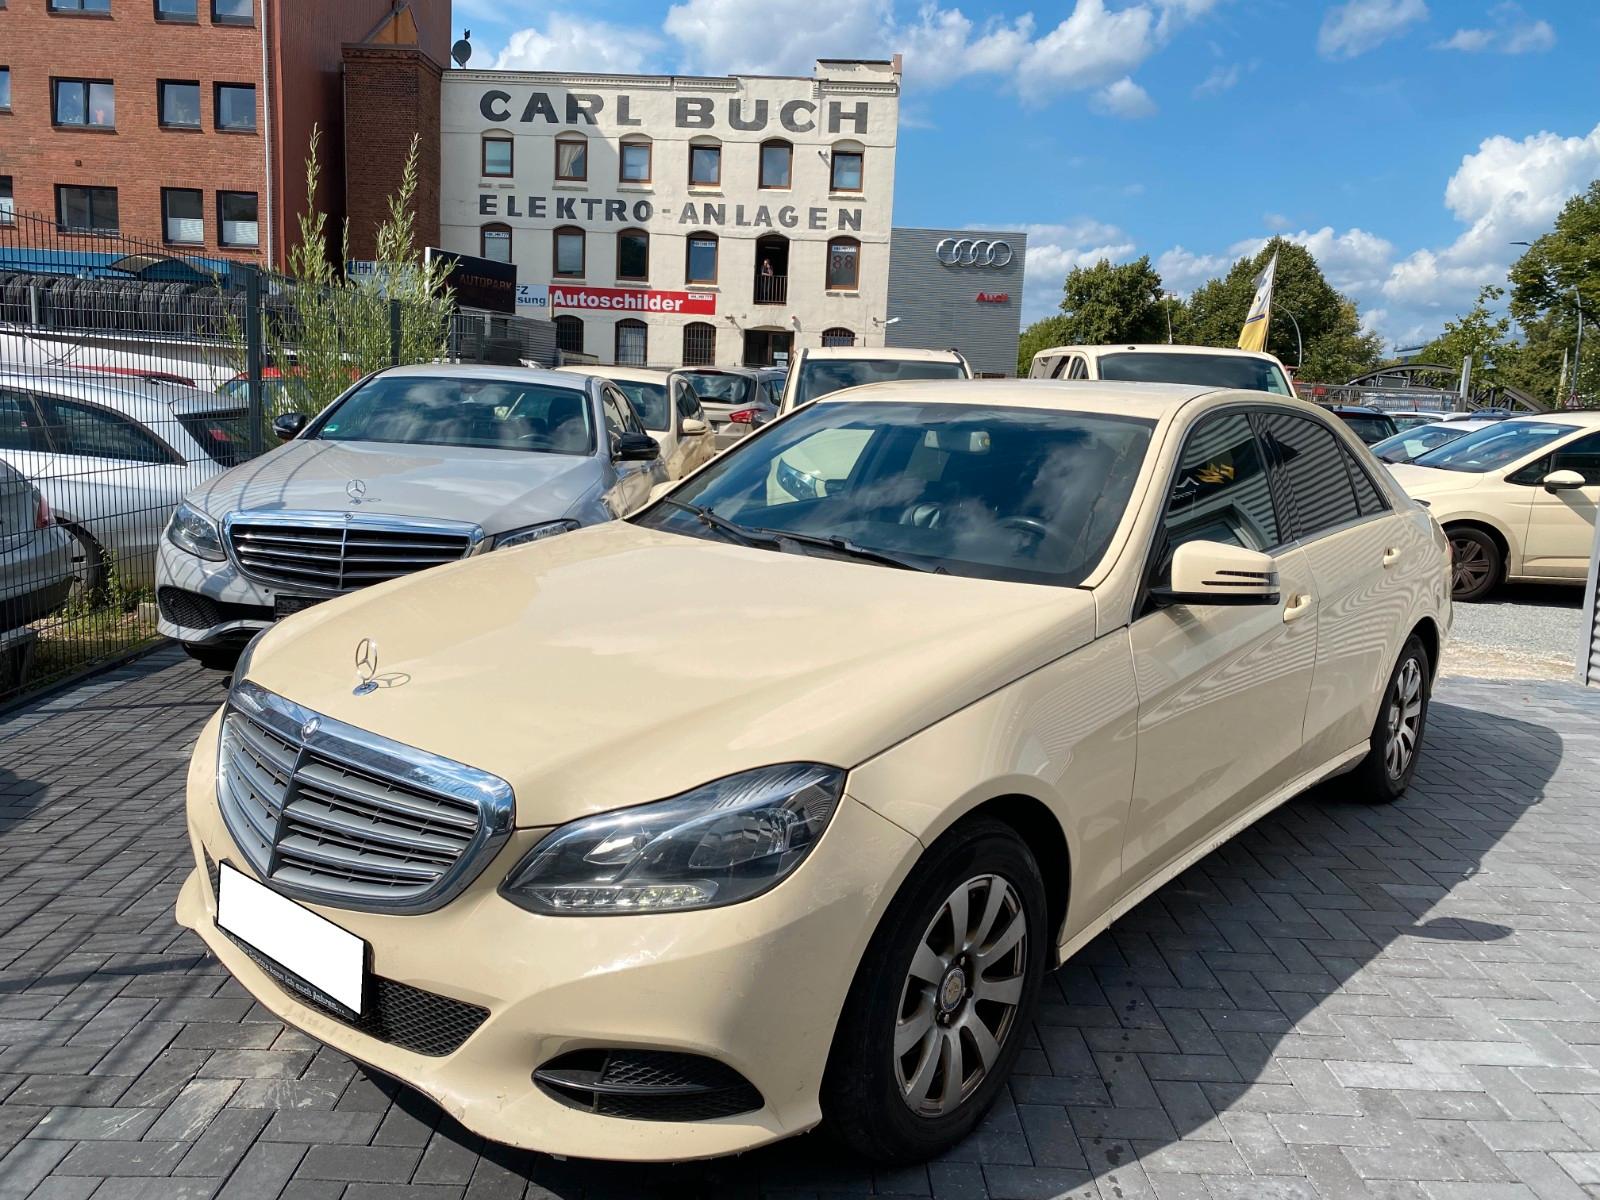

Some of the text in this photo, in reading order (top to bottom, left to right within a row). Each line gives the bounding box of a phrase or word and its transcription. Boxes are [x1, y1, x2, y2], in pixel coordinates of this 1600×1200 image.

[479, 90, 869, 134] CARL BUCH
[553, 289, 683, 312] Autoschilder
[975, 290, 1009, 304] Audi
